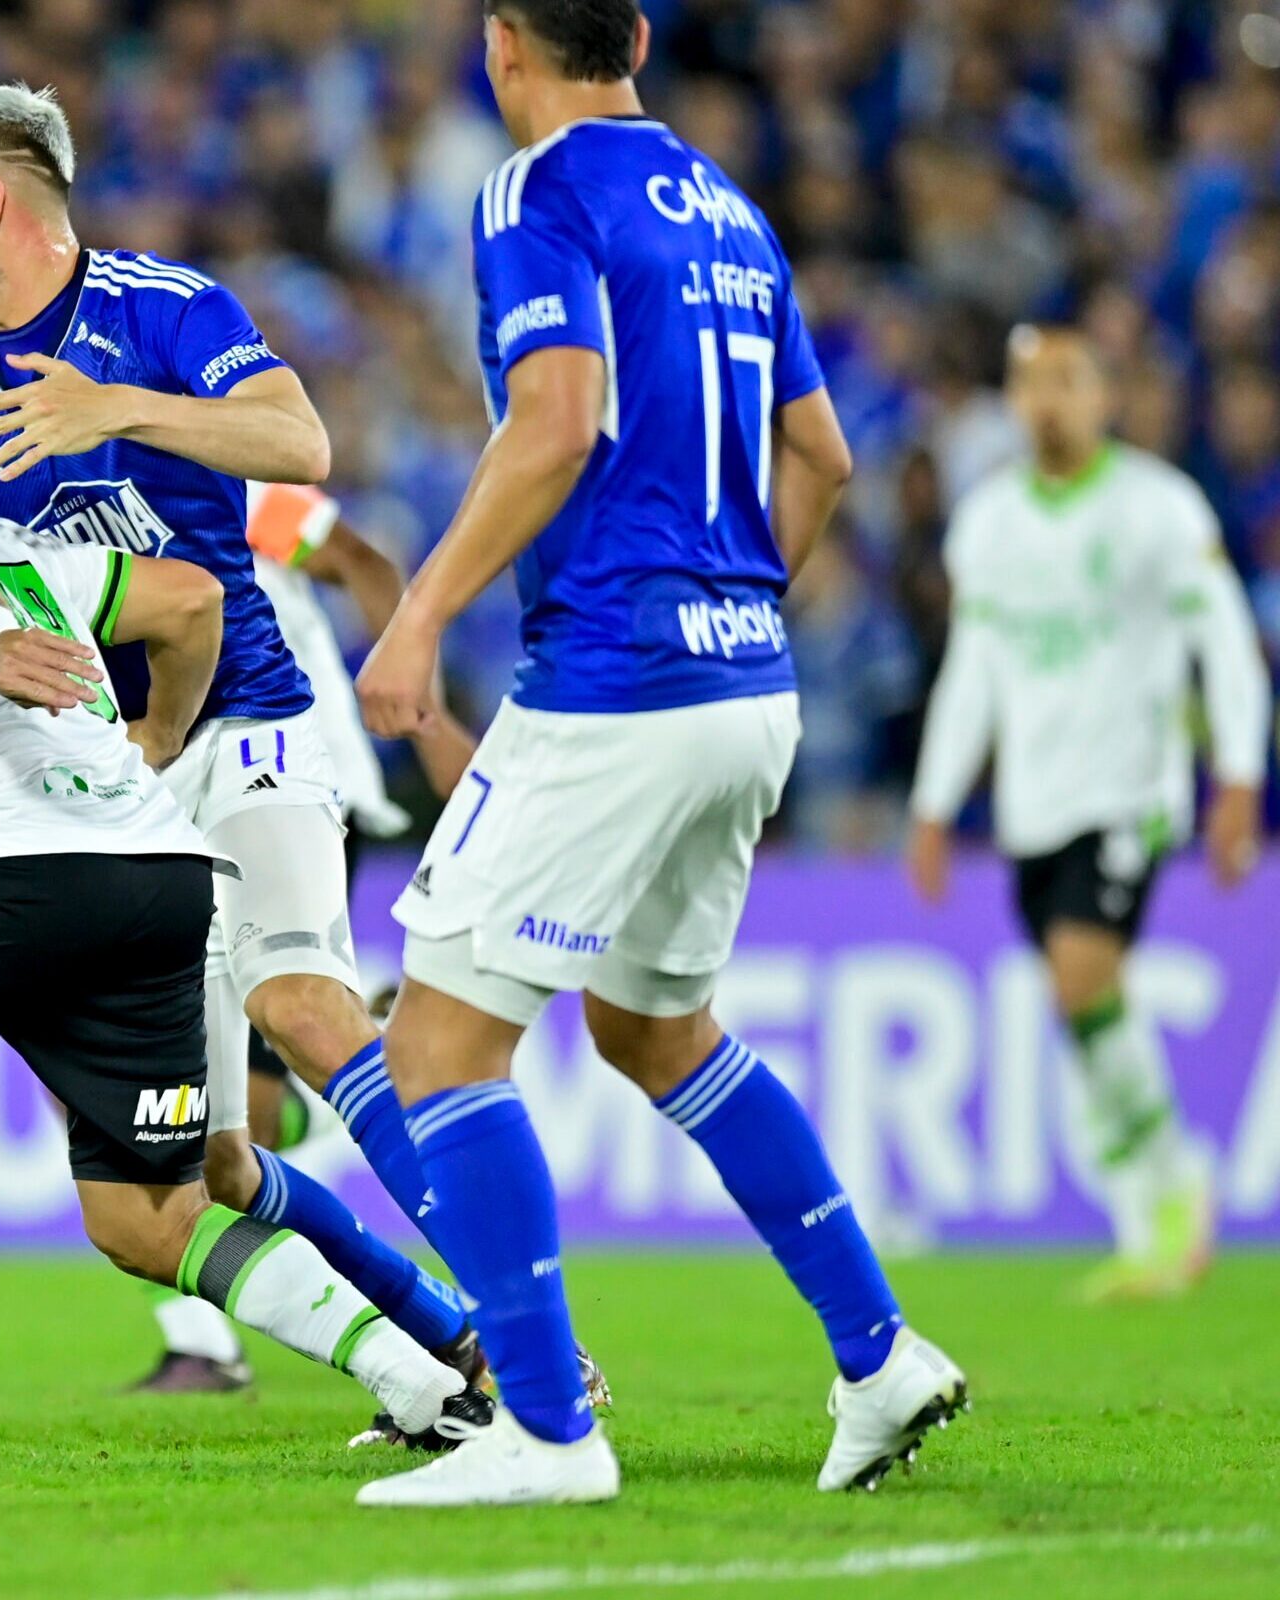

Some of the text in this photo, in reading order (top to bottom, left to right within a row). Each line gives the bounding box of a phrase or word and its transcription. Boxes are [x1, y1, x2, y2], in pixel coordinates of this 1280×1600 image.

[681, 261, 711, 305] J.
[698, 327, 776, 525] 17
[239, 729, 286, 773] 4
[515, 913, 610, 955] Allianz
[135, 1130, 175, 1144] Aluguel
[174, 1130, 186, 1140] de
